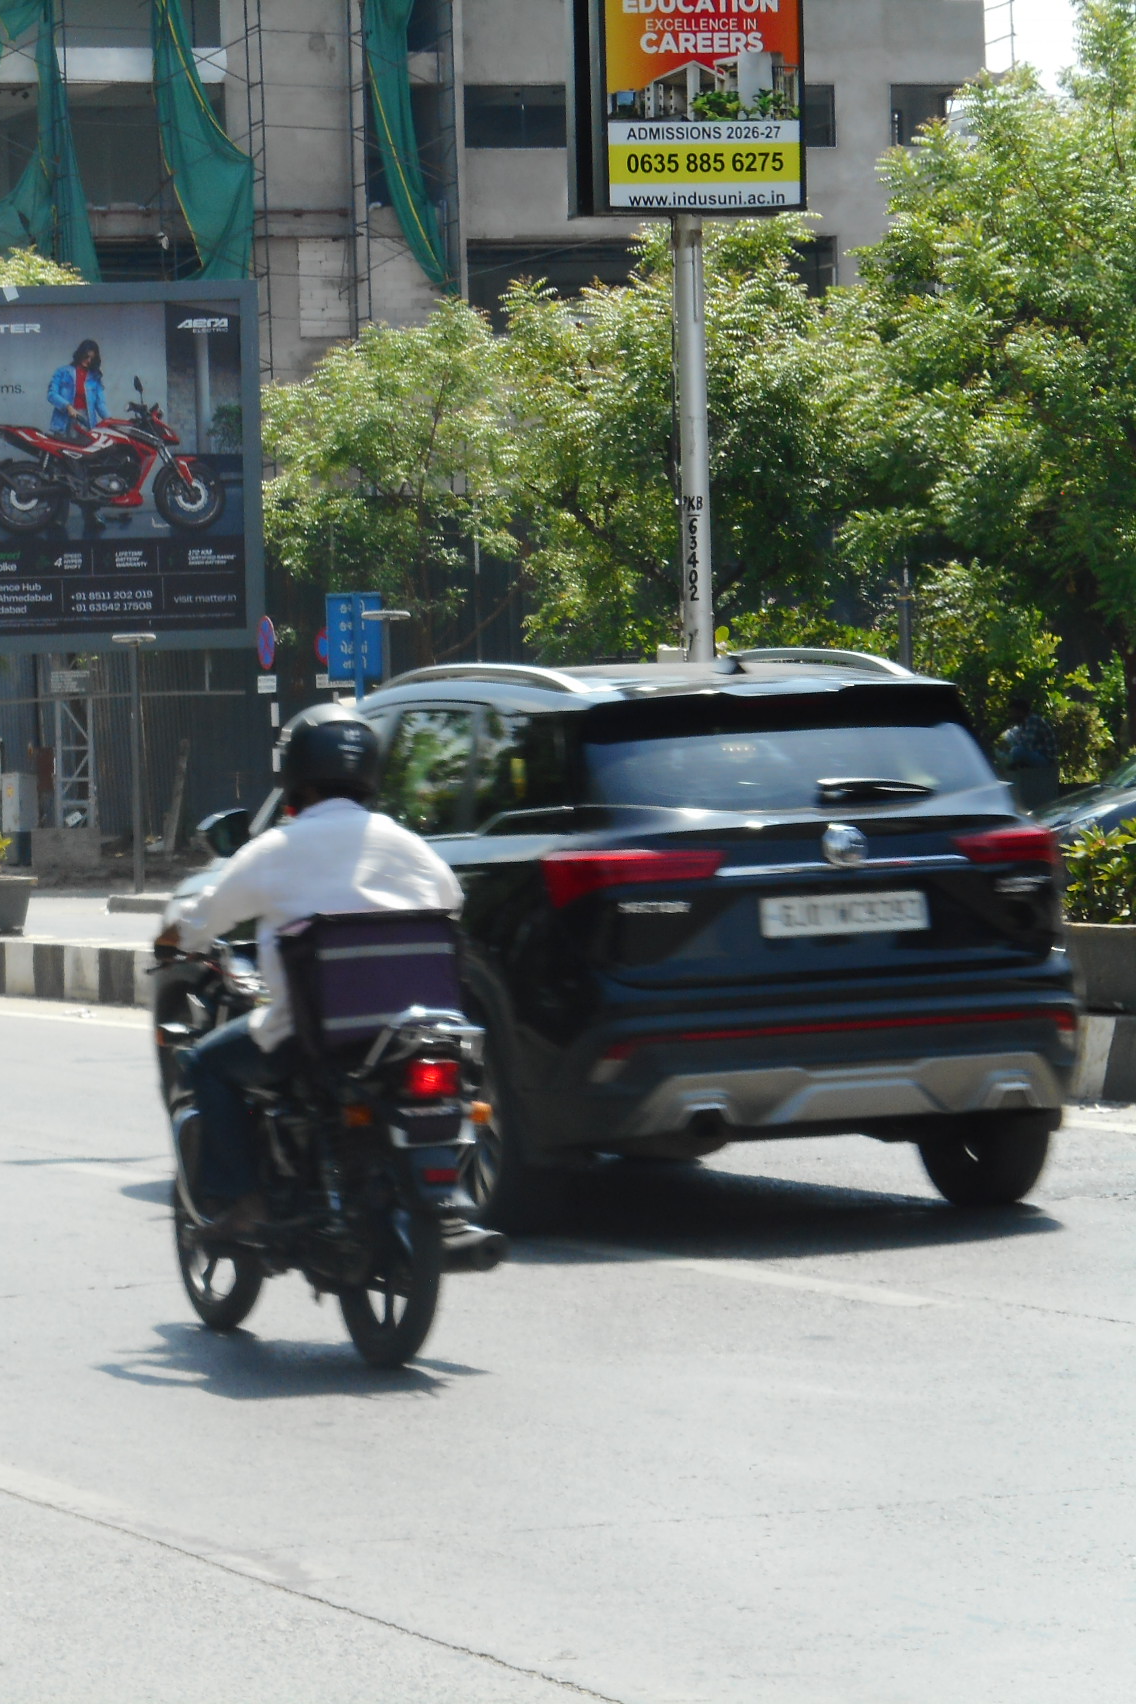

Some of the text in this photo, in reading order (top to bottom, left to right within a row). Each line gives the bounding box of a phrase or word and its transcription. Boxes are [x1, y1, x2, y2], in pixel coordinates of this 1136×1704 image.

[622, 0, 779, 14] EDUCATION
[645, 18, 757, 31] EXCELLENCE IN
[640, 32, 764, 54] CAREERS
[627, 125, 781, 140] ADMISSIONS 2026-27
[626, 152, 784, 173] 0635 885 6275
[628, 190, 785, 206] www.indusuni.ac.in
[22, 583, 42, 592] Hub
[113, 591, 133, 600] 202
[135, 590, 153, 599] 019
[174, 594, 193, 603] visit
